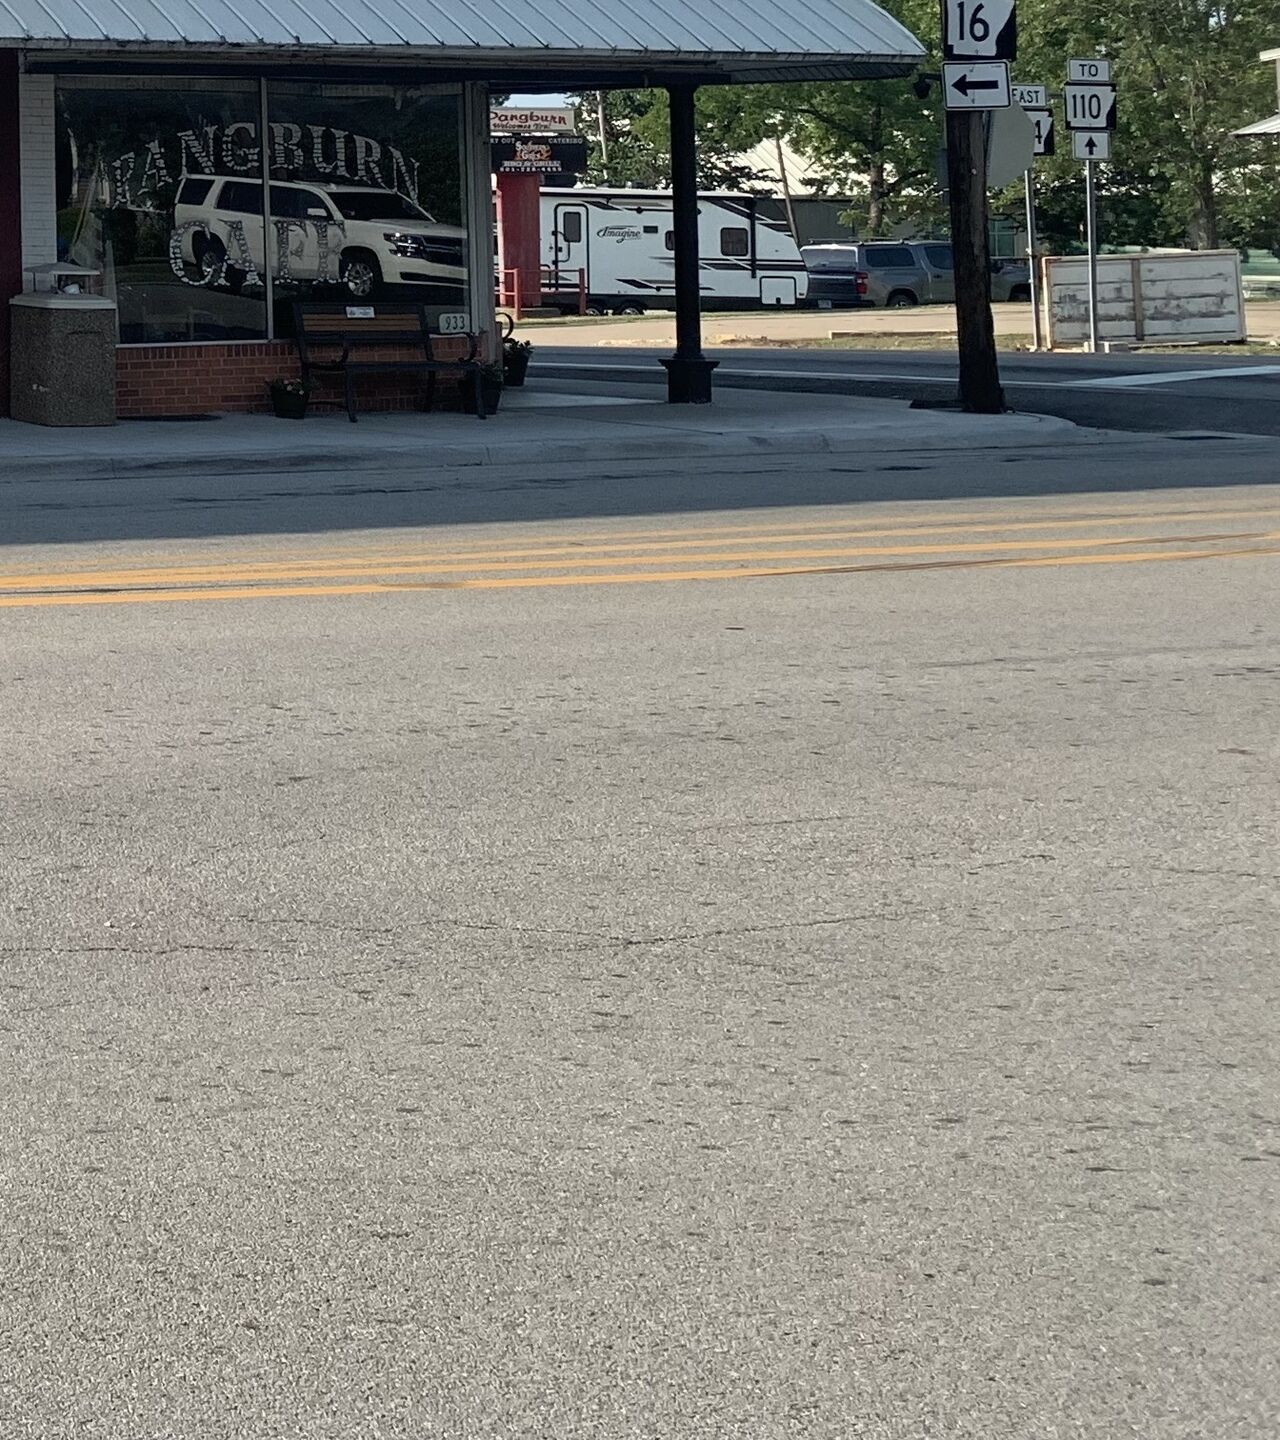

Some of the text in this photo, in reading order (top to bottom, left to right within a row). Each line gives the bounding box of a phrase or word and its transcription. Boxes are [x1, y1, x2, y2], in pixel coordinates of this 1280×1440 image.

[957, 1, 990, 42] 16
[1079, 64, 1099, 77] TO
[1072, 94, 1101, 120] 110
[596, 226, 641, 244] Imagine
[443, 315, 466, 331] 933
